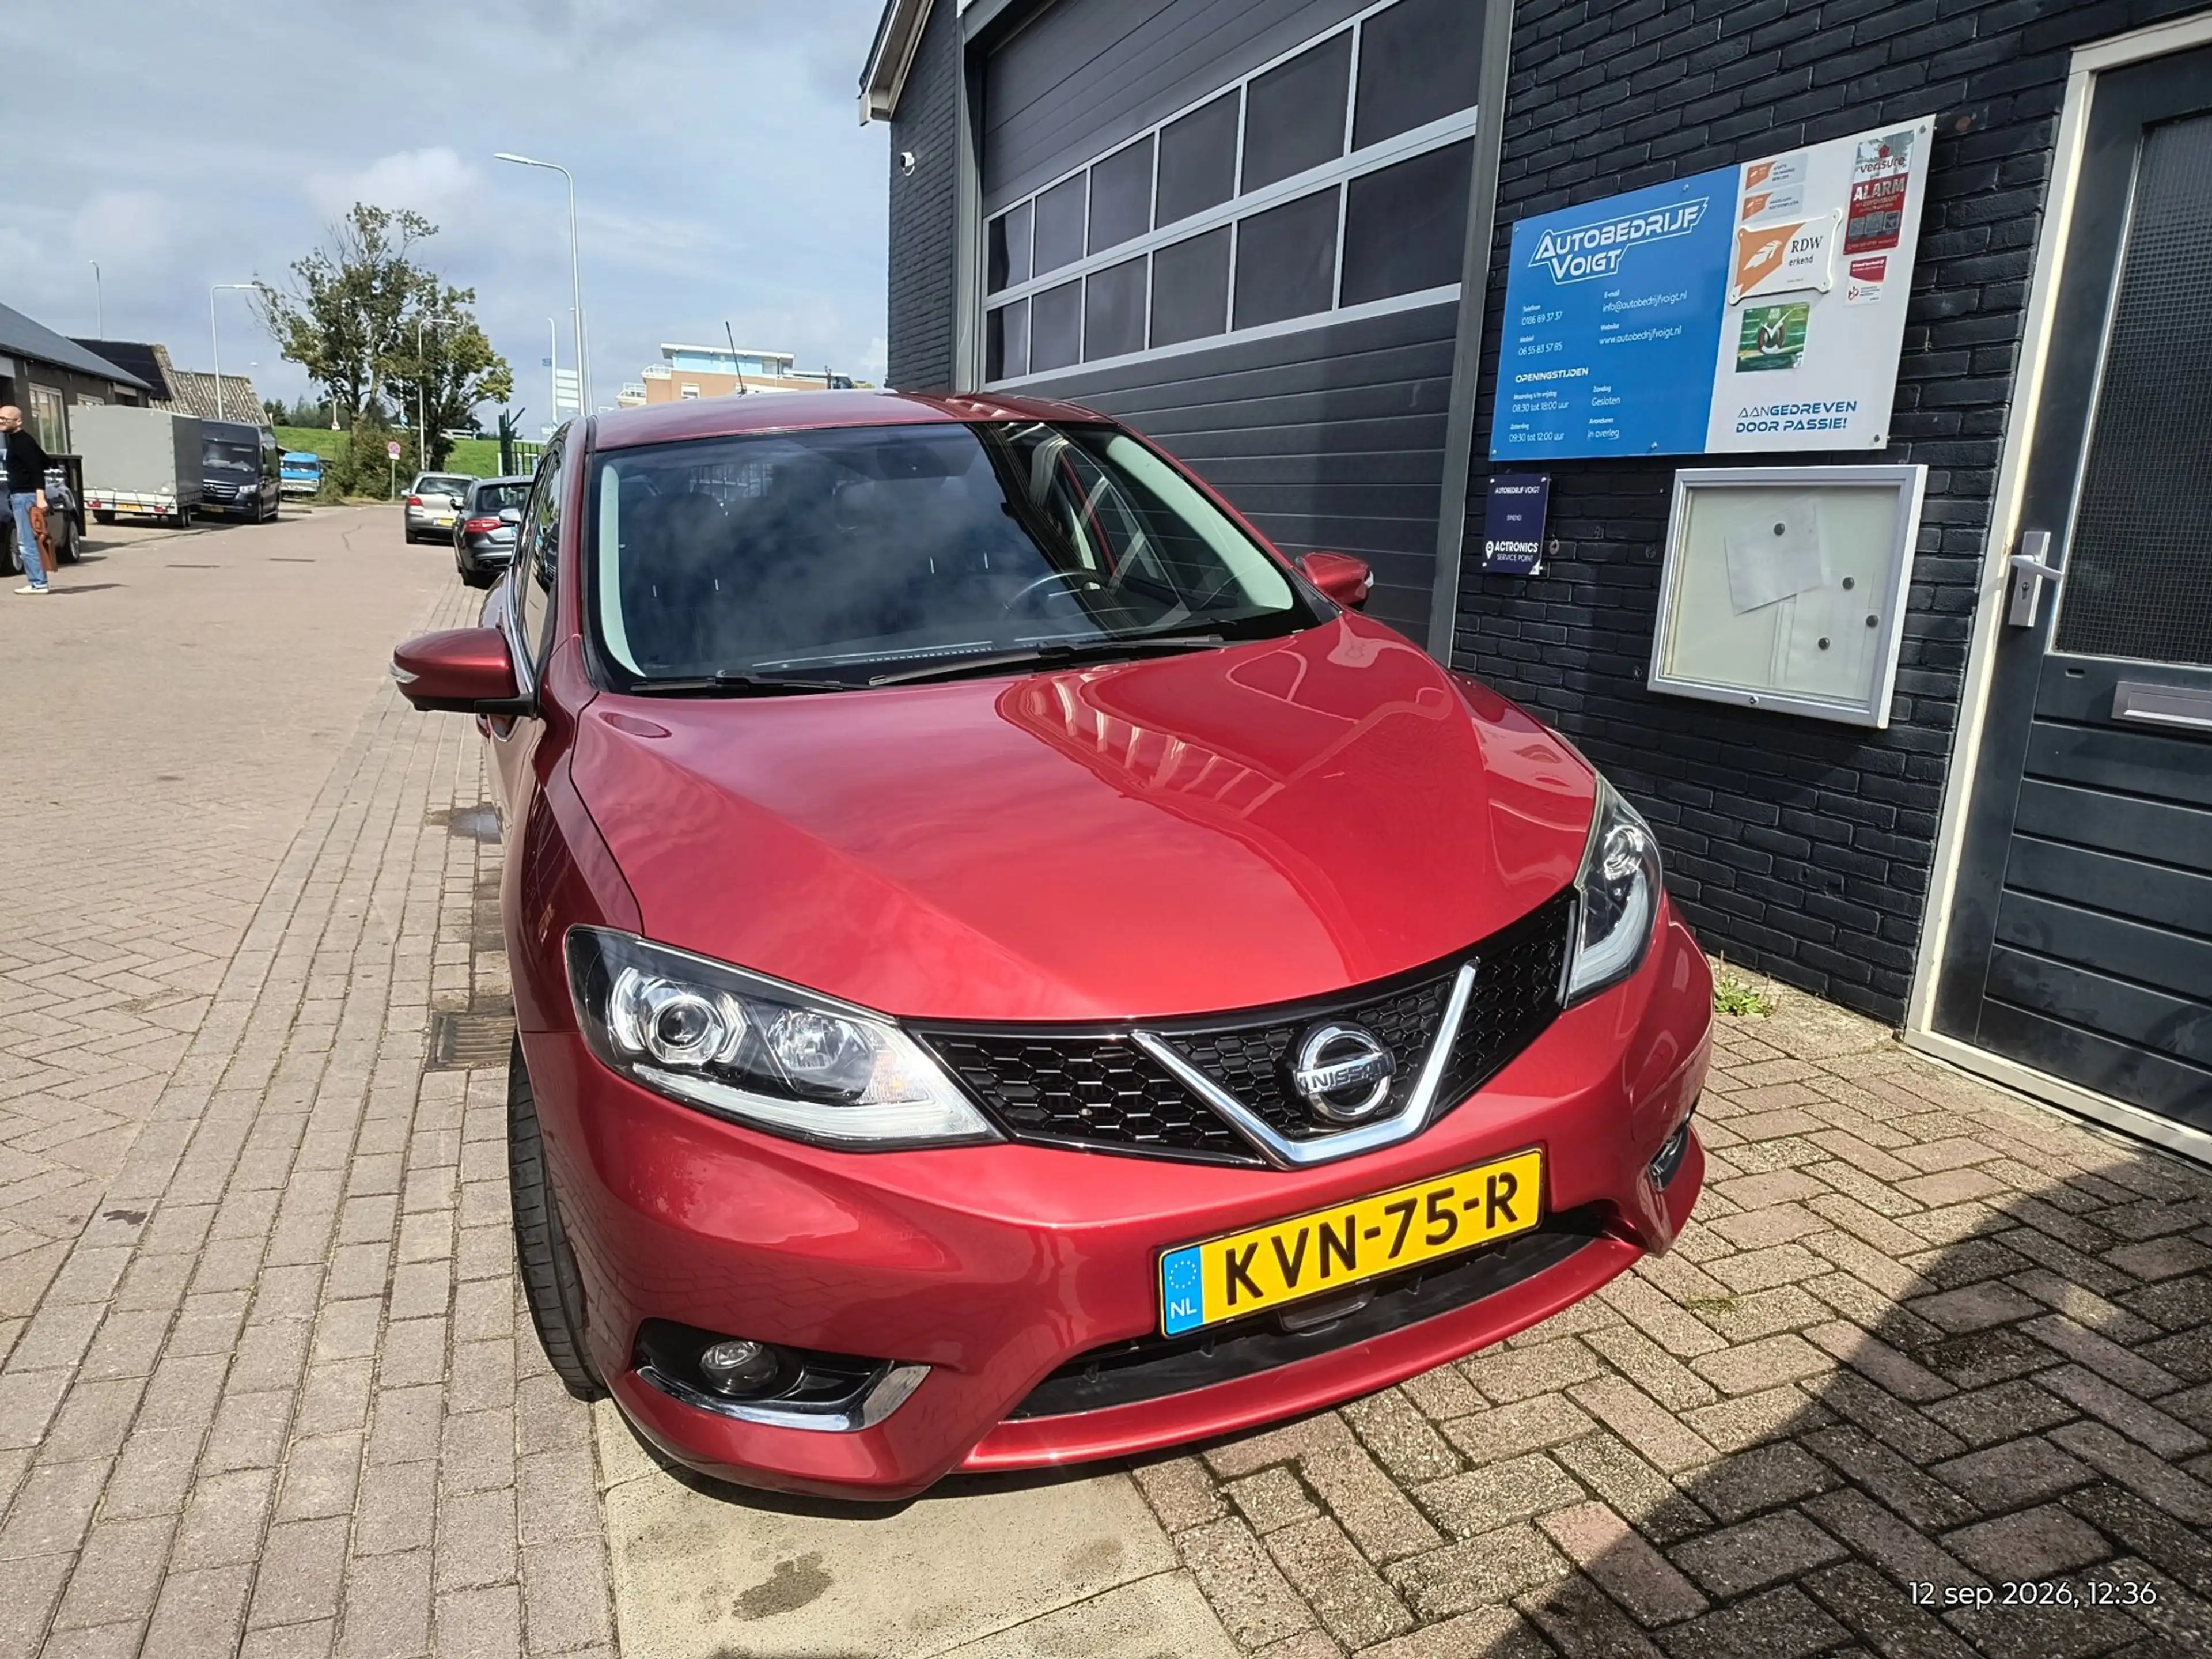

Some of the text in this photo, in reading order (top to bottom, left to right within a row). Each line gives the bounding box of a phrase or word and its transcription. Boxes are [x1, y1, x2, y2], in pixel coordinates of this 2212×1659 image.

[1853, 177, 1906, 202] ALARM
[1535, 205, 1700, 259] AUTOBEDRIJF
[1791, 235, 1823, 253] RDW
[1552, 248, 1622, 279] VOIGT
[1789, 255, 1813, 267] erkend
[1603, 290, 1688, 313] info@autobedrijfvoigt.nl
[1599, 325, 1682, 345] www.autobedrijfvoigt.nl
[1515, 367, 1589, 383] OPENINGSTIJDEN
[1531, 403, 1540, 412] tot
[1591, 396, 1621, 407] Gesloten
[1738, 400, 1857, 418] AANGEDREVEN
[1736, 417, 1847, 433] DOOR PASSIE!
[1527, 433, 1536, 441] tot
[1554, 433, 1565, 441] uur
[1594, 428, 1620, 440] overleg
[1494, 541, 1539, 553] ACTRONICS
[1497, 554, 1533, 562] SERVICE POINT
[1225, 1170, 1519, 1306] KVN-75-R
[1170, 1297, 1198, 1320] NL
